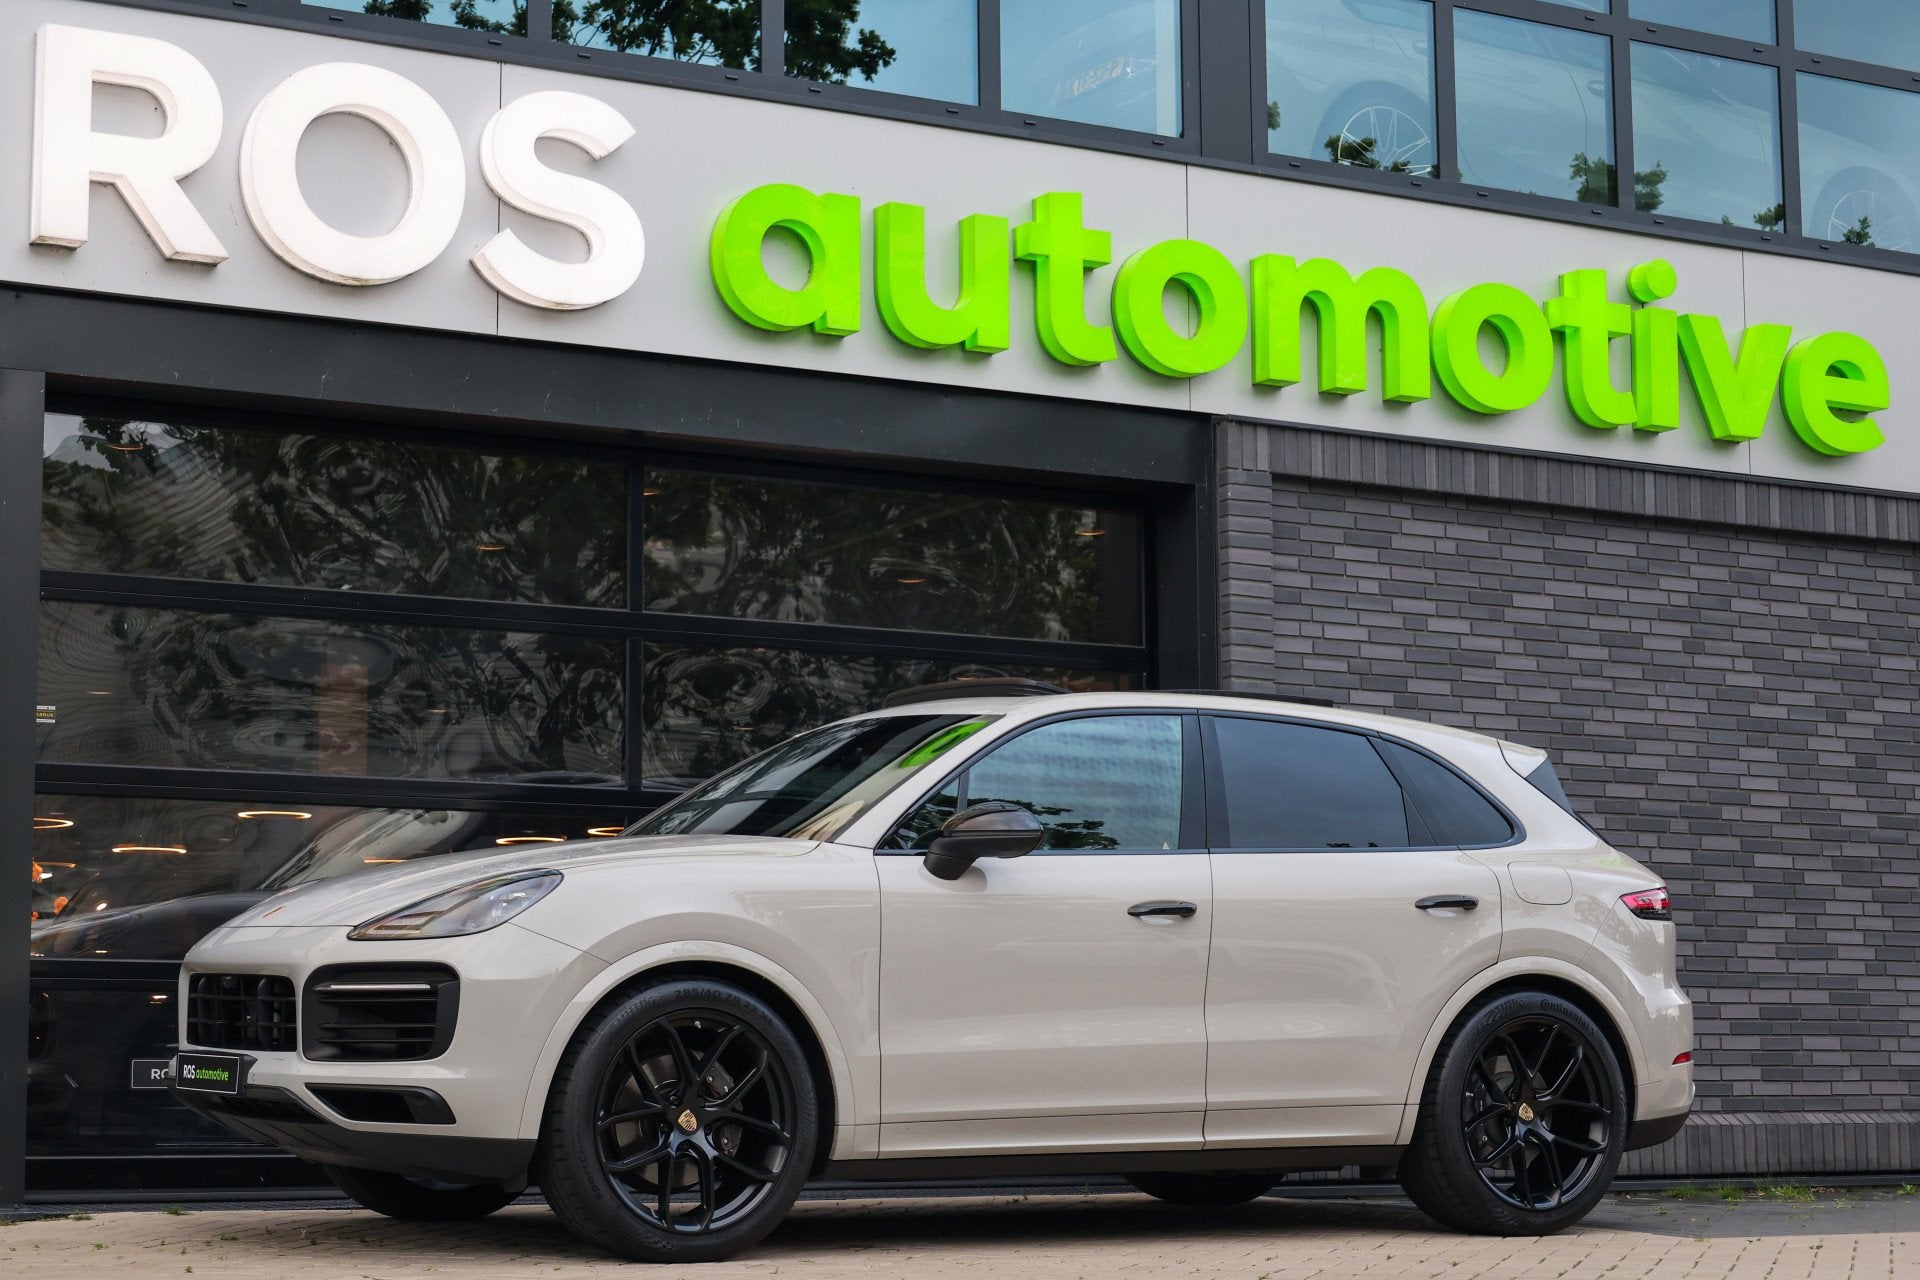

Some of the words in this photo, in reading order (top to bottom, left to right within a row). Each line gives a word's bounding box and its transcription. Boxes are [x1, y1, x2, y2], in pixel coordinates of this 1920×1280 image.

[29, 23, 645, 311] ROS
[709, 183, 1889, 457] automotive
[1541, 999, 1590, 1030] Continental
[184, 1065, 195, 1079] ROS
[196, 1068, 229, 1080] automotive
